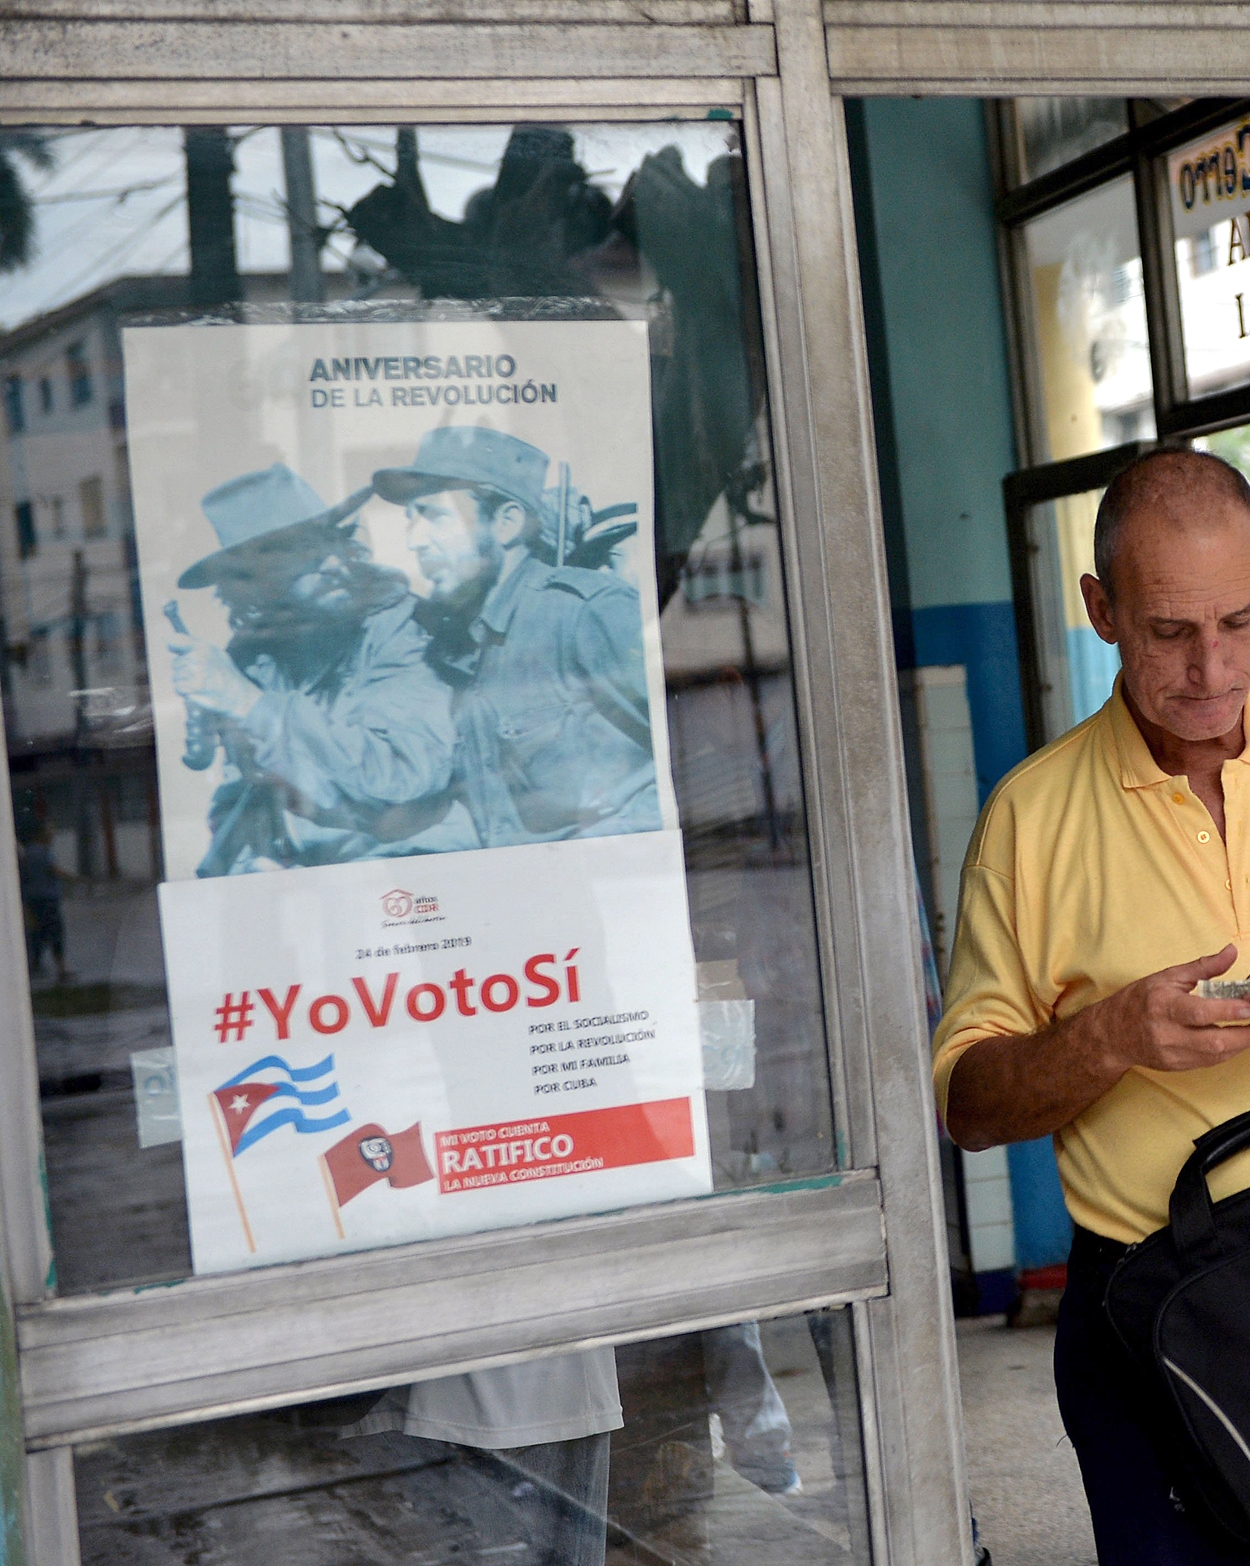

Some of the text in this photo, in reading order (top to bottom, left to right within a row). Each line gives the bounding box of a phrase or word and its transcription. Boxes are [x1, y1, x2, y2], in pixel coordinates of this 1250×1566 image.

[309, 353, 517, 382] ANIVERSARIO
[311, 379, 558, 408] DE LA REVOLUCIÓN
[212, 948, 581, 1043] #YoVotoSí
[529, 1010, 649, 1035] POR EL SOCIALISMO
[529, 1043, 557, 1055] POR
[558, 1040, 576, 1052] LA
[532, 1053, 630, 1075] POR MI FAMILIA
[533, 1077, 598, 1095] POR CUBA
[440, 1121, 550, 1147] MI VOTO CUENTA
[441, 1133, 574, 1174] RATIFICO
[444, 1156, 604, 1191] LA NUEVA CONSTITUCIÓN
